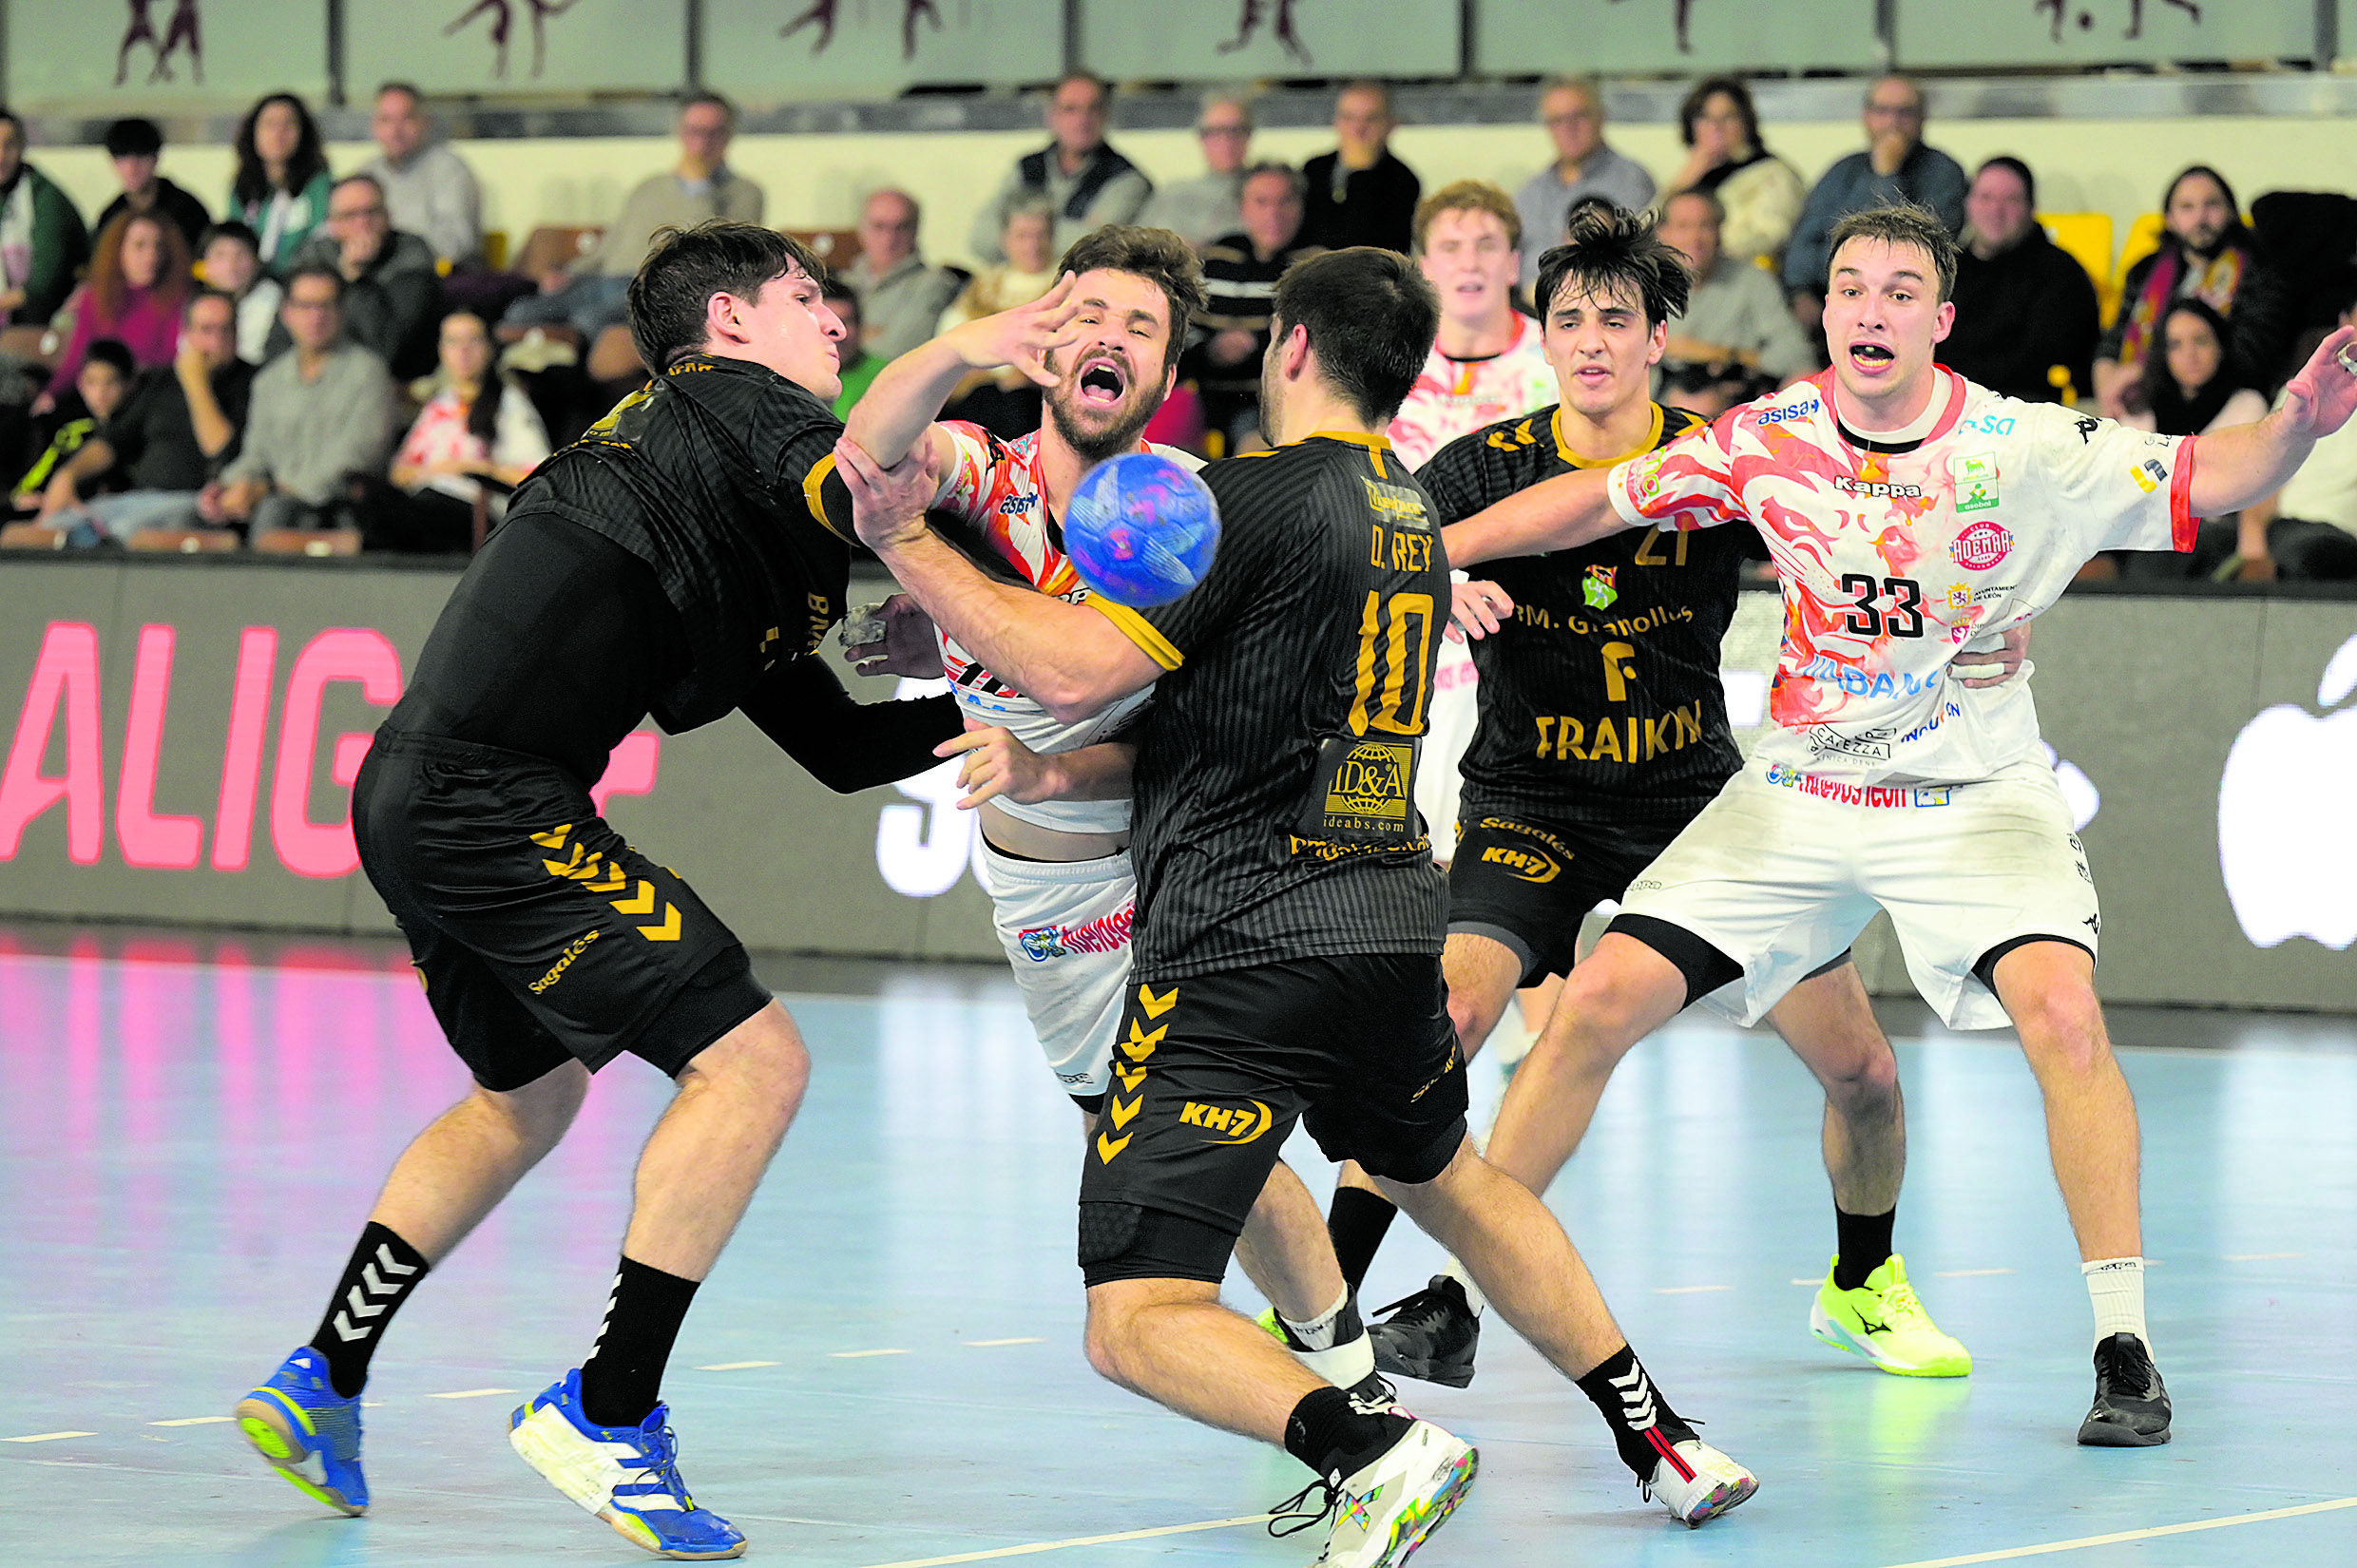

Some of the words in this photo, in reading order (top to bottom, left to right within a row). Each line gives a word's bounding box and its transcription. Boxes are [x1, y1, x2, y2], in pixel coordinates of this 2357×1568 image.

[1833, 476, 1922, 499] Kappa
[1391, 531, 1433, 572] REY
[1842, 573, 1924, 639] 33
[1348, 589, 1434, 736] 10
[1536, 699, 1702, 764] FRAIKIN
[1332, 760, 1404, 797] ID&A
[1323, 816, 1405, 832] ideabs.com
[1480, 817, 1576, 860] Sagalés
[528, 930, 600, 995] Sagalés
